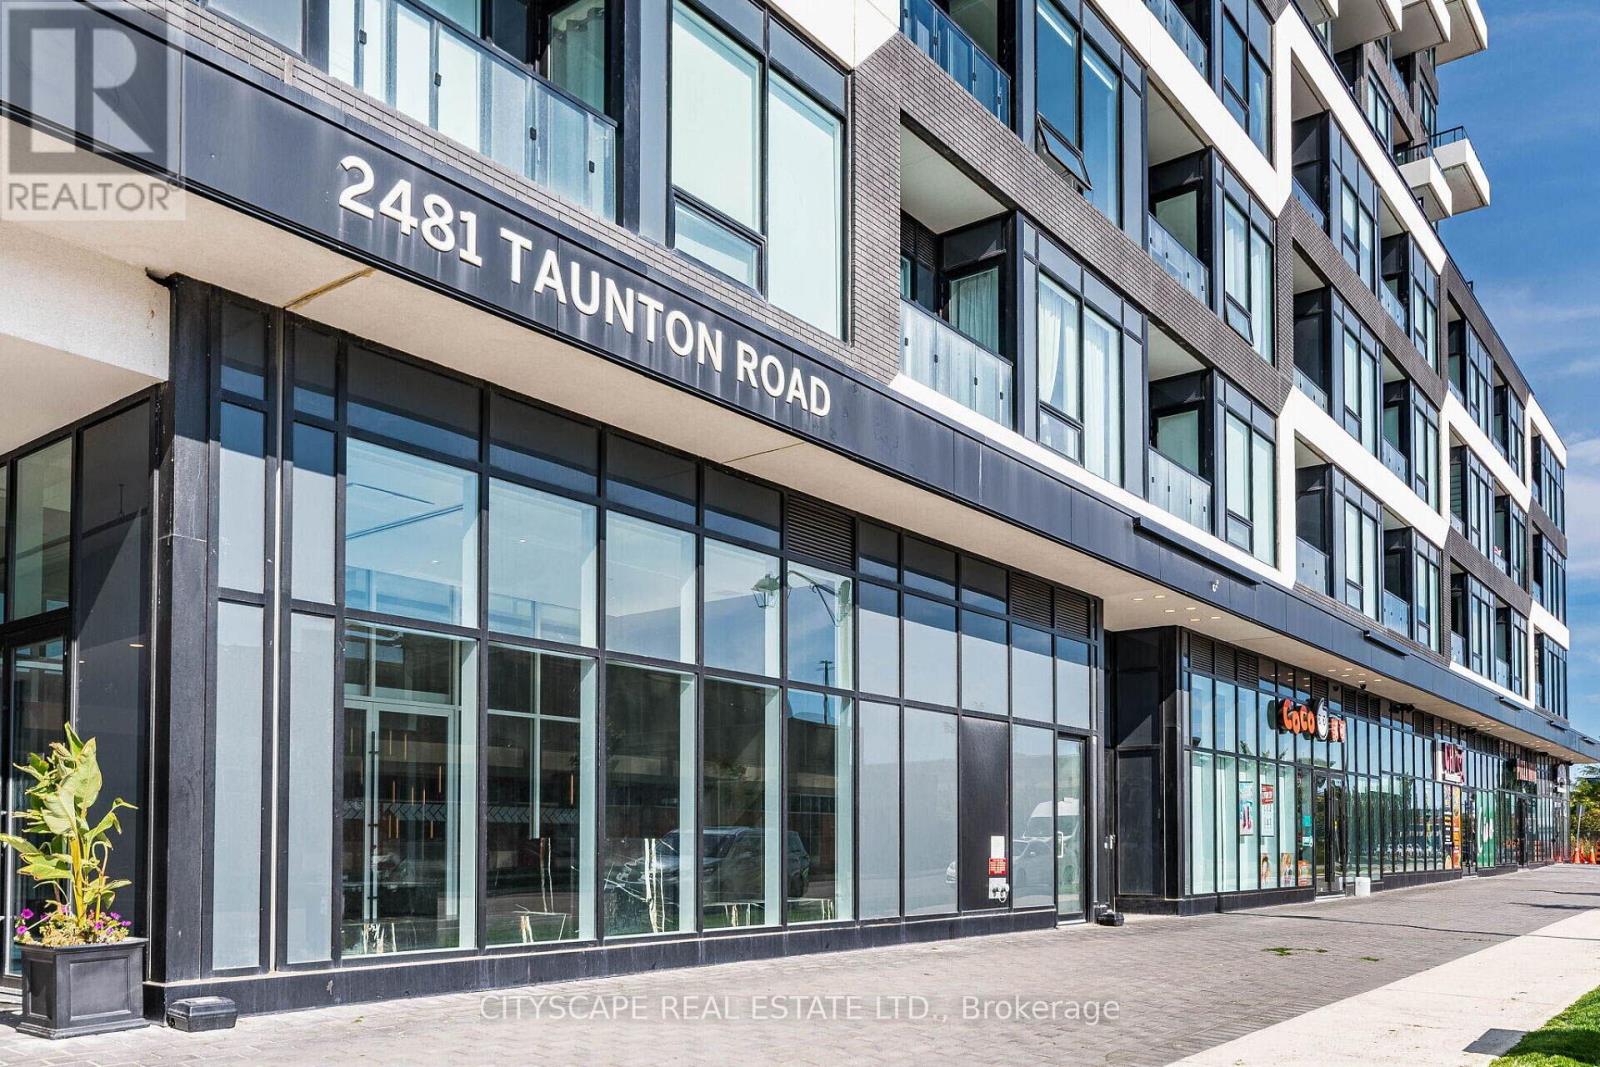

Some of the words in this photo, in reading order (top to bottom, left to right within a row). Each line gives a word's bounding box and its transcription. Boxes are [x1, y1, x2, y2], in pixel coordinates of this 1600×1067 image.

[338, 155, 483, 268] 2481
[500, 227, 723, 373] TAUNTON
[736, 340, 831, 417] ROAD
